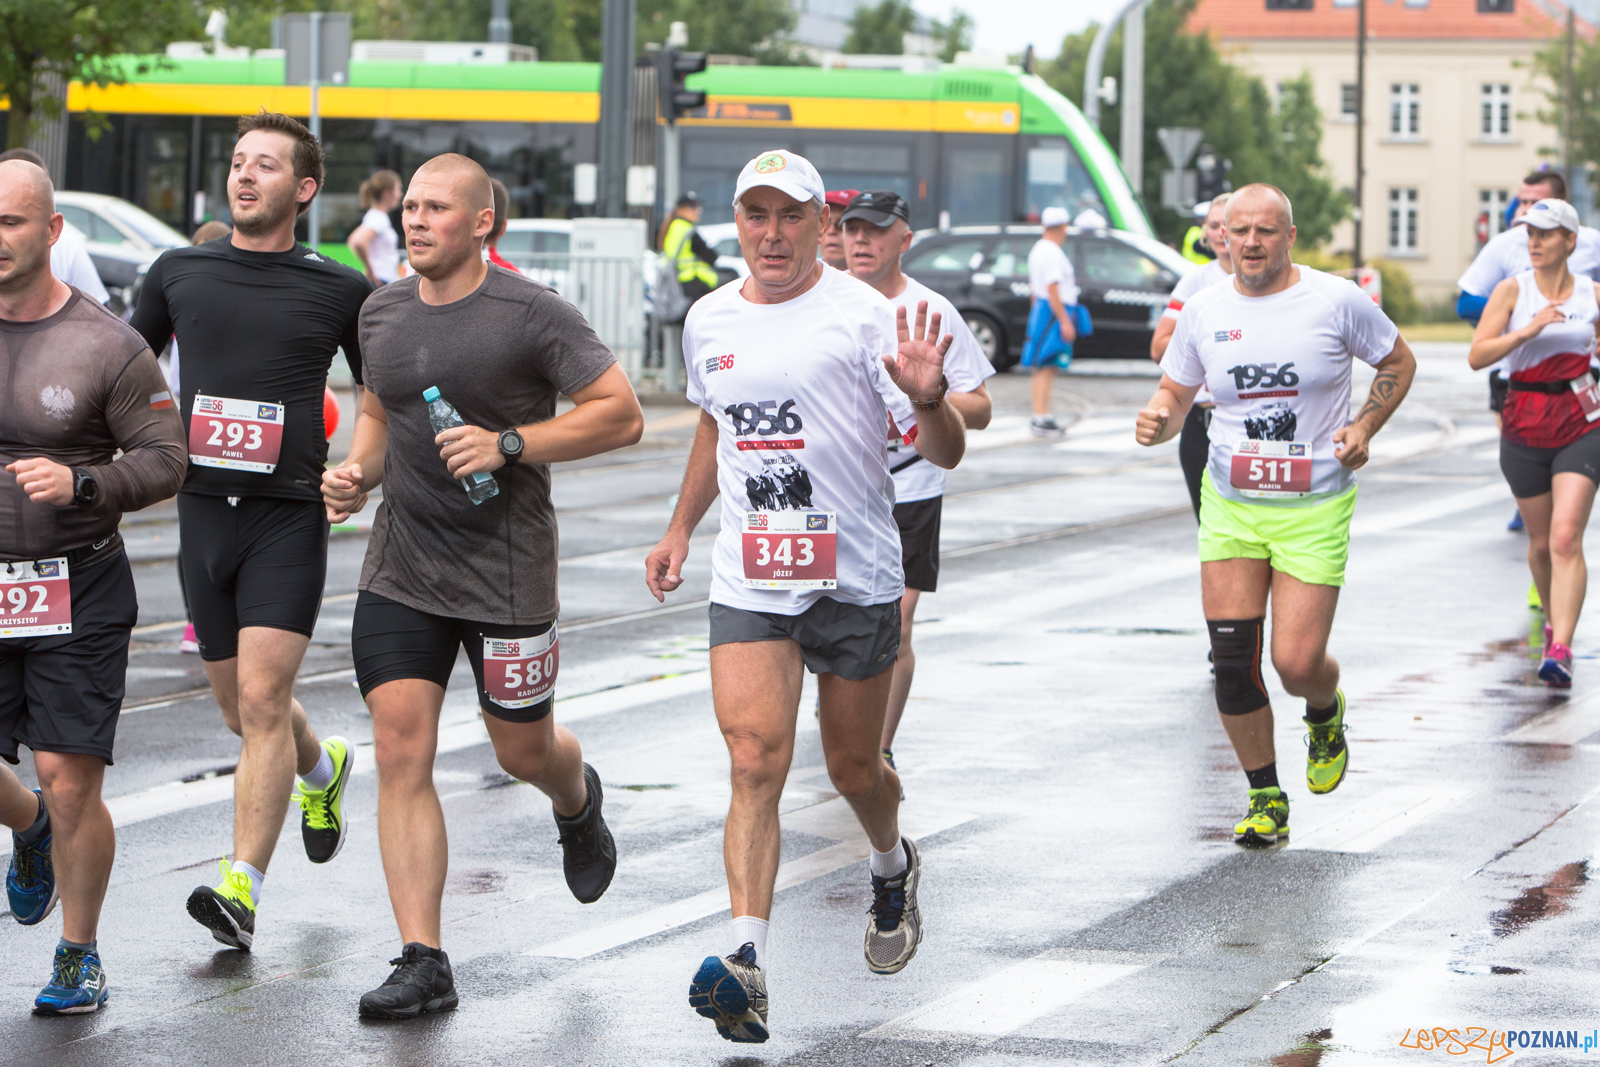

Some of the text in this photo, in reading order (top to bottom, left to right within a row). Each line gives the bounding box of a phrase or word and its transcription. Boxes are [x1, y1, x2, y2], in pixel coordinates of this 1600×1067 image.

[1227, 361, 1300, 390] 1956
[724, 398, 803, 437] 1956
[206, 420, 263, 450] 293
[222, 450, 243, 459] PAWEŁ
[1248, 459, 1292, 482] 511
[756, 537, 815, 566] 343
[773, 569, 793, 578] JÓZEF
[0, 585, 49, 615] 92
[504, 652, 554, 689] 580
[517, 682, 549, 698] RADOSŁAW
